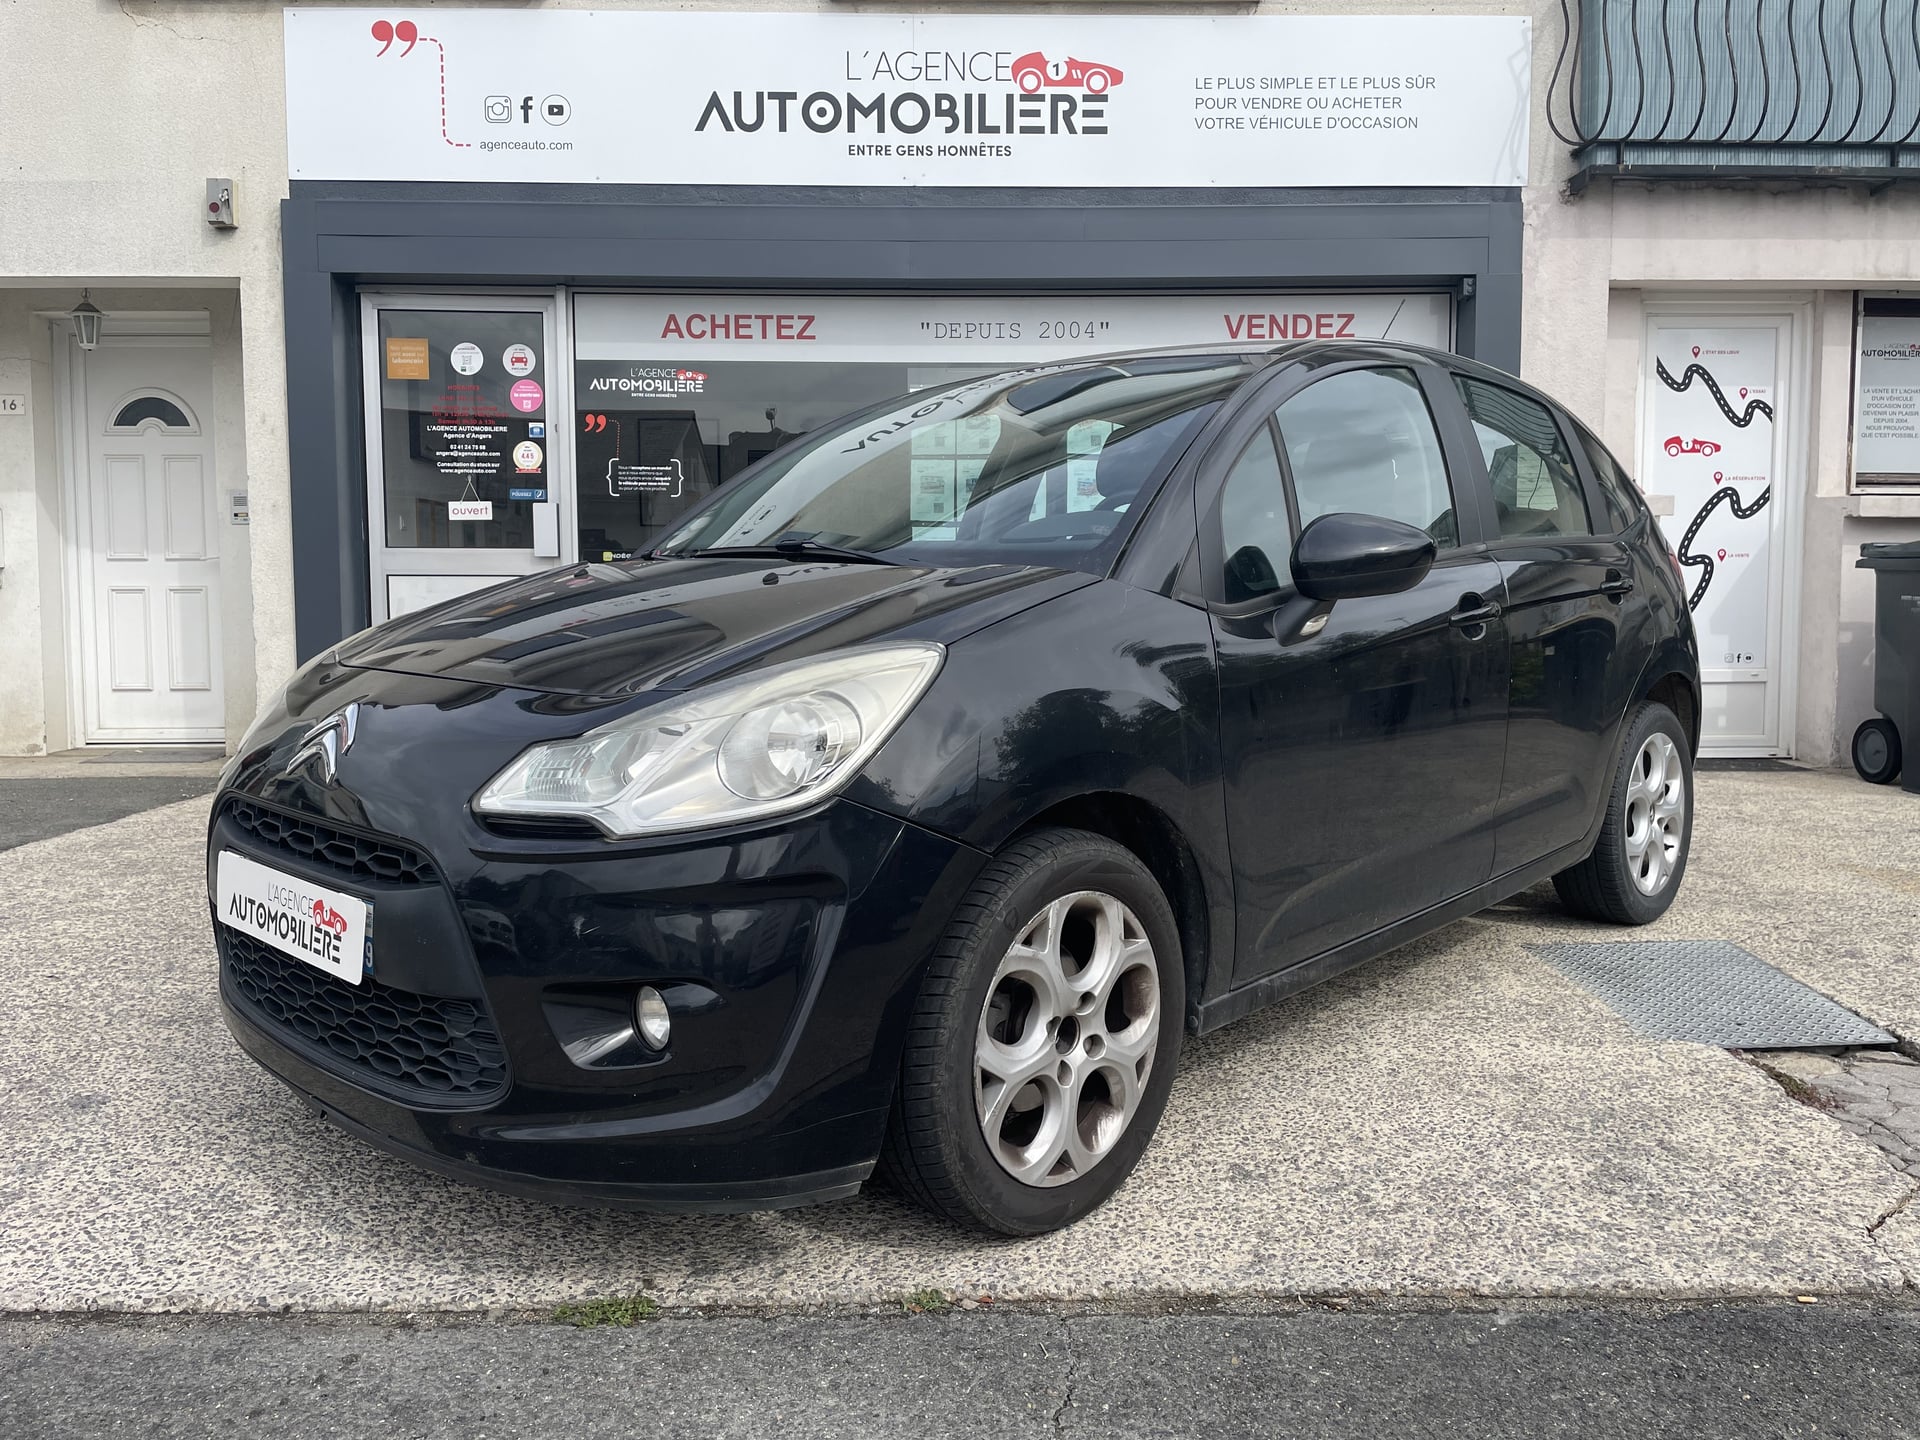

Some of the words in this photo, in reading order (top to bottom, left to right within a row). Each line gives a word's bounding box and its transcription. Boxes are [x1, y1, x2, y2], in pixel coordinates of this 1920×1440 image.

[845, 50, 1012, 82] L'AGENCE
[1195, 77, 1213, 90] LE
[1217, 77, 1256, 90] PLUS
[1260, 77, 1313, 90] SIMPLE
[1318, 77, 1336, 90] ET
[1340, 77, 1358, 90] LE
[1362, 77, 1401, 90] PLUS
[1405, 74, 1436, 90] SÛR
[1195, 97, 1237, 110] POUR
[1241, 97, 1302, 110] VENDRE
[1306, 97, 1328, 110] OU
[1332, 97, 1402, 110] ACHETER
[694, 90, 1109, 135] AUTOMOBILIERE
[1194, 117, 1245, 130] VOTRE
[1249, 115, 1322, 130] VÉHICULE
[1327, 117, 1418, 130] D'OCCASION
[480, 140, 573, 152] agenceauto.com
[848, 144, 892, 157] ENTRE
[895, 144, 934, 157] GENS
[938, 142, 1012, 158] HONNÊTES
[660, 314, 816, 340] ACHETEZ
[920, 320, 1022, 340] "DEPUIS
[1038, 320, 1112, 340] 2004"
[1224, 313, 1356, 340] VENDEZ
[630, 368, 676, 378] L'AGENCE
[589, 378, 704, 392] AUTOMOBILIERE
[2, 399, 16, 410] 16
[452, 506, 488, 515] ouvert
[268, 881, 313, 918] L'AGENCE
[230, 893, 342, 964] AUTOMOBILIERE
